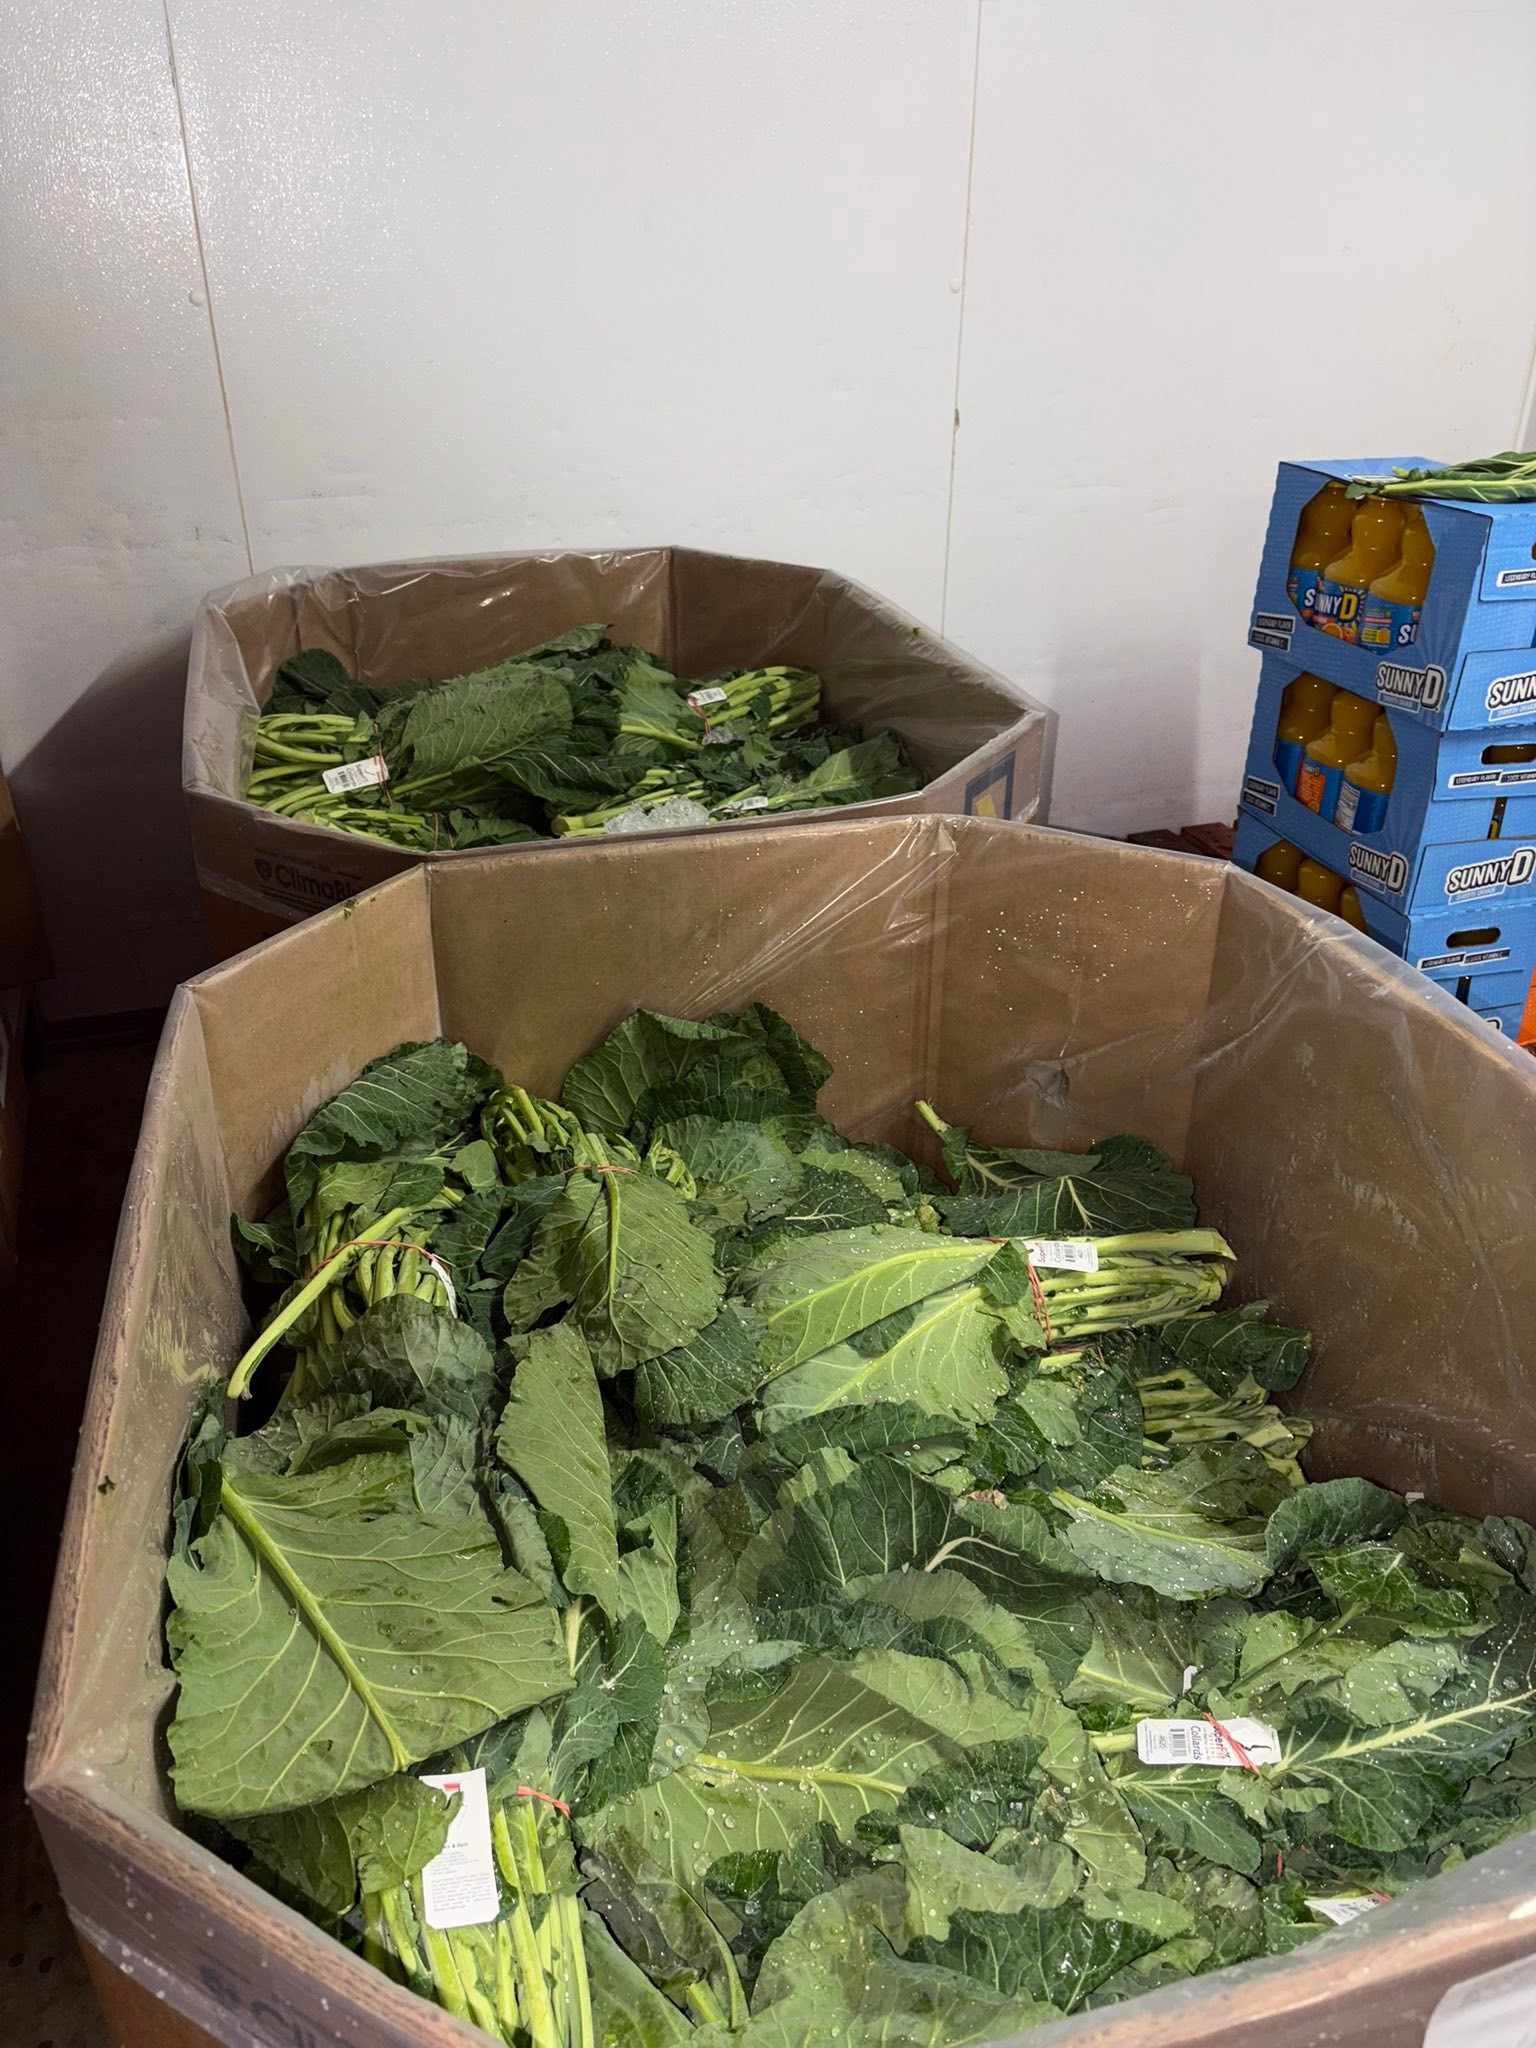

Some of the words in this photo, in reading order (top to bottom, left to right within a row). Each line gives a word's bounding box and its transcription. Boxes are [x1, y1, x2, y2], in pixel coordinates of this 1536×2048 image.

[1376, 664, 1443, 707] SUNNYD
[1489, 674, 1536, 707] SUNN
[275, 865, 351, 900] ClimaBi
[1350, 845, 1406, 891] SUNNYD
[1448, 849, 1535, 892] SUNNYD
[1190, 1725, 1203, 1760] Collards
